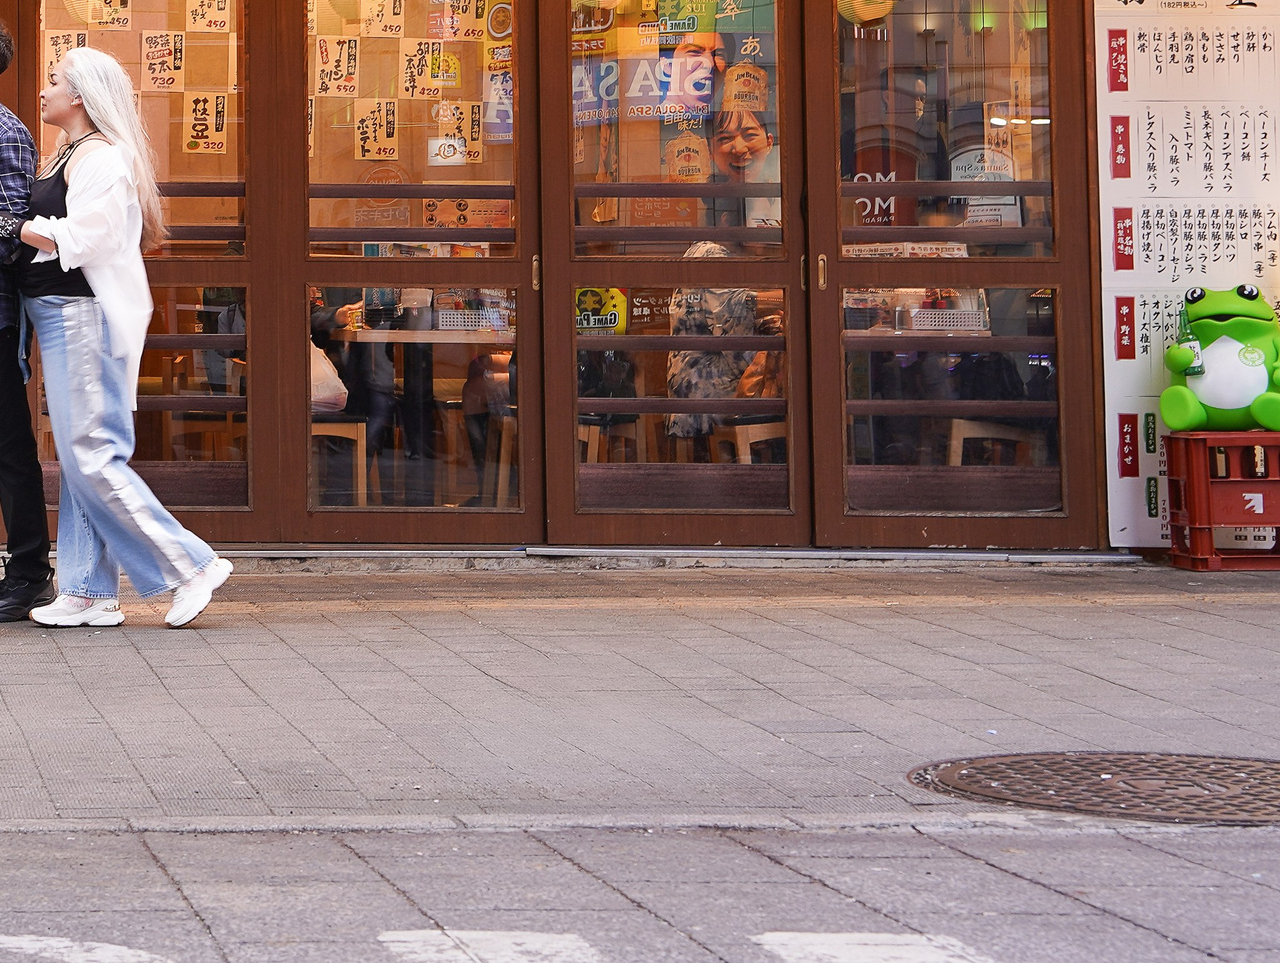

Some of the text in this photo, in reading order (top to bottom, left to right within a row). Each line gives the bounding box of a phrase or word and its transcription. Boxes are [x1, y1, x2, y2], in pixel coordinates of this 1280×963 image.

[686, 4, 707, 13] SUI
[464, 28, 484, 37] 650
[1137, 32, 1148, 53] 軟骨
[1153, 32, 1163, 74] ぼんじり
[1168, 32, 1179, 64] 手羽先
[1199, 32, 1210, 63] 鳥もも
[1215, 32, 1225, 63] ささみ
[1231, 32, 1241, 63] せせり
[1262, 32, 1272, 52] かわ
[151, 77, 175, 85] 730
[336, 85, 356, 93] 550
[203, 141, 224, 150] 320
[1146, 111, 1158, 193] レタス入り豚バラ
[1183, 111, 1193, 161] ミニトマト
[1202, 111, 1214, 193] 長ネギ入り豚バラ
[1258, 111, 1270, 182] ベーコンチーズ
[1170, 133, 1180, 187] 入り豚バラ
[1140, 209, 1152, 263] 厚揚げ焼き
[1154, 209, 1167, 273] 厚切ベーコン
[1183, 209, 1194, 274] 厚切豚カシラ
[1196, 209, 1207, 274] 厚切豚ハラミ
[1210, 209, 1222, 262] 厚切豚タン
[1224, 209, 1236, 262] 厚切豚ハツ
[1238, 209, 1248, 240] 豚シロ
[1252, 209, 1263, 252] 豚バラ串
[1168, 209, 1180, 283] 自家製ソーセージ
[1152, 300, 1162, 332] オクラ
[1123, 424, 1132, 465] おまかせ
